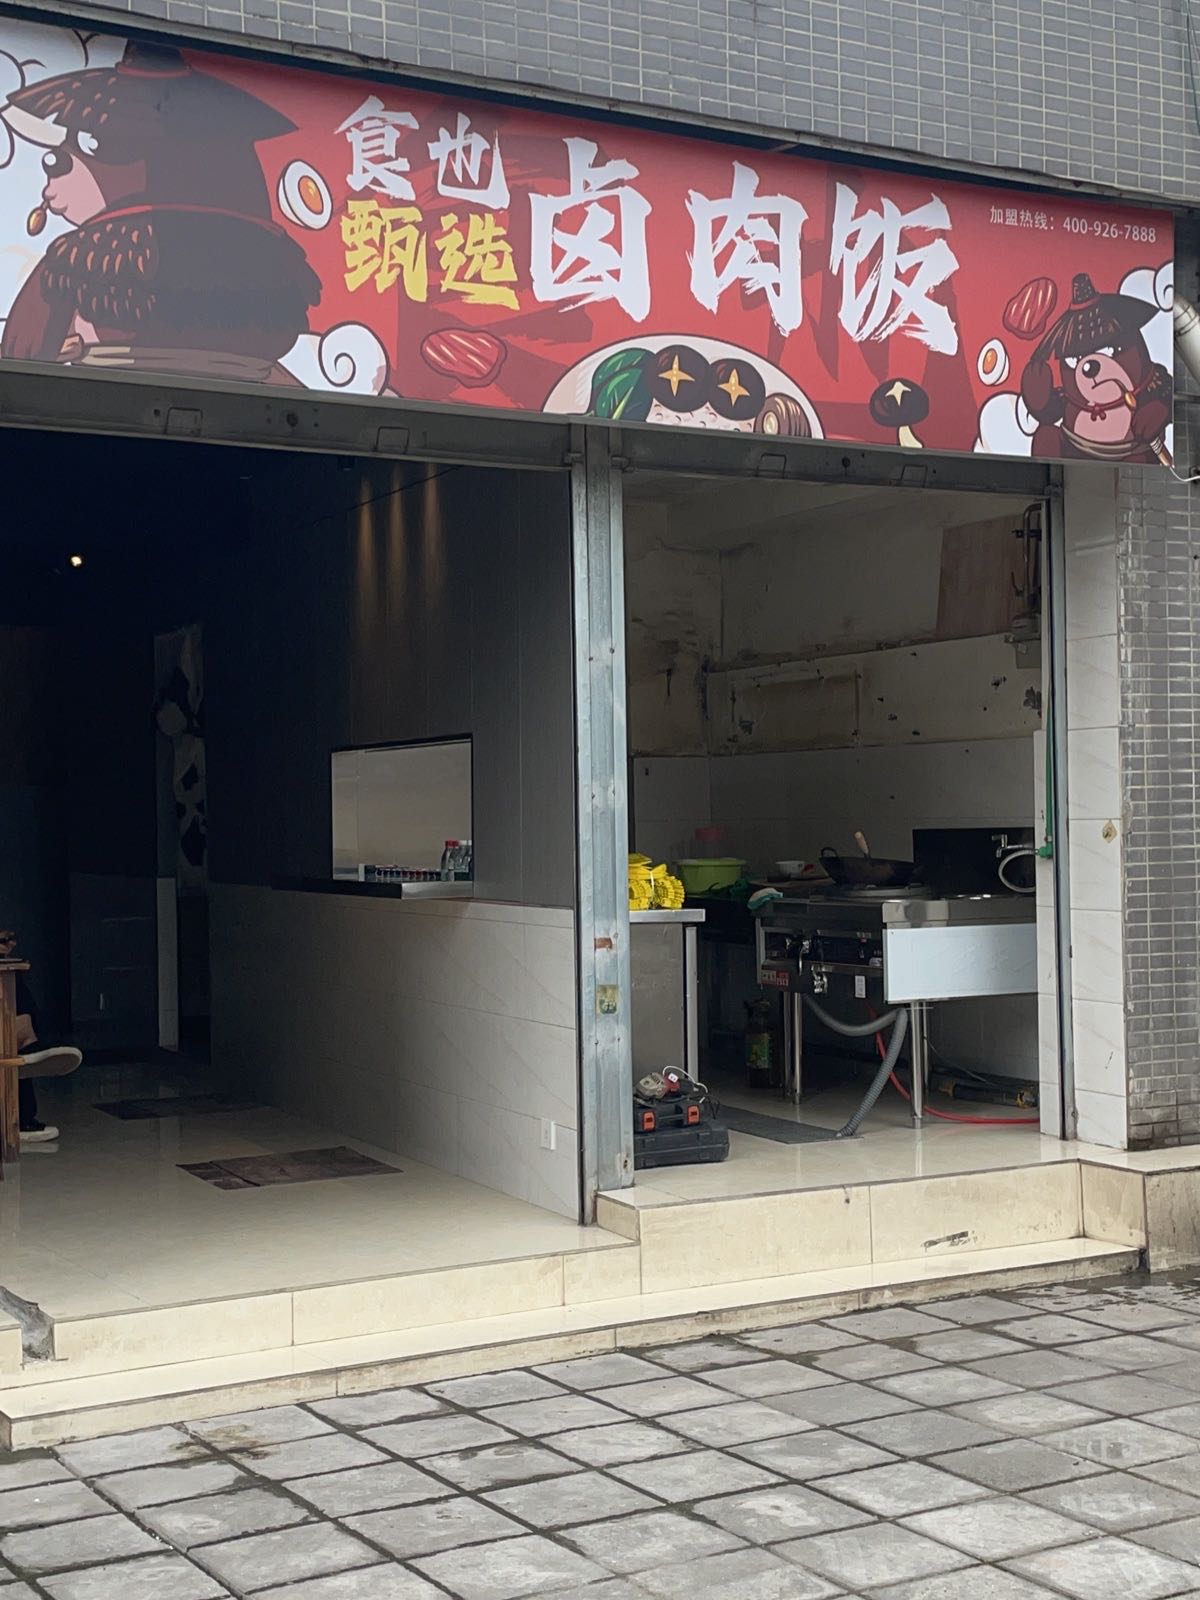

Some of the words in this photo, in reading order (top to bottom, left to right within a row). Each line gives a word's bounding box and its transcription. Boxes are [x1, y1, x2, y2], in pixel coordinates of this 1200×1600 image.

[334, 94, 510, 209] 食也
[340, 199, 520, 310] 甄选
[528, 136, 959, 357] 卤肉饭
